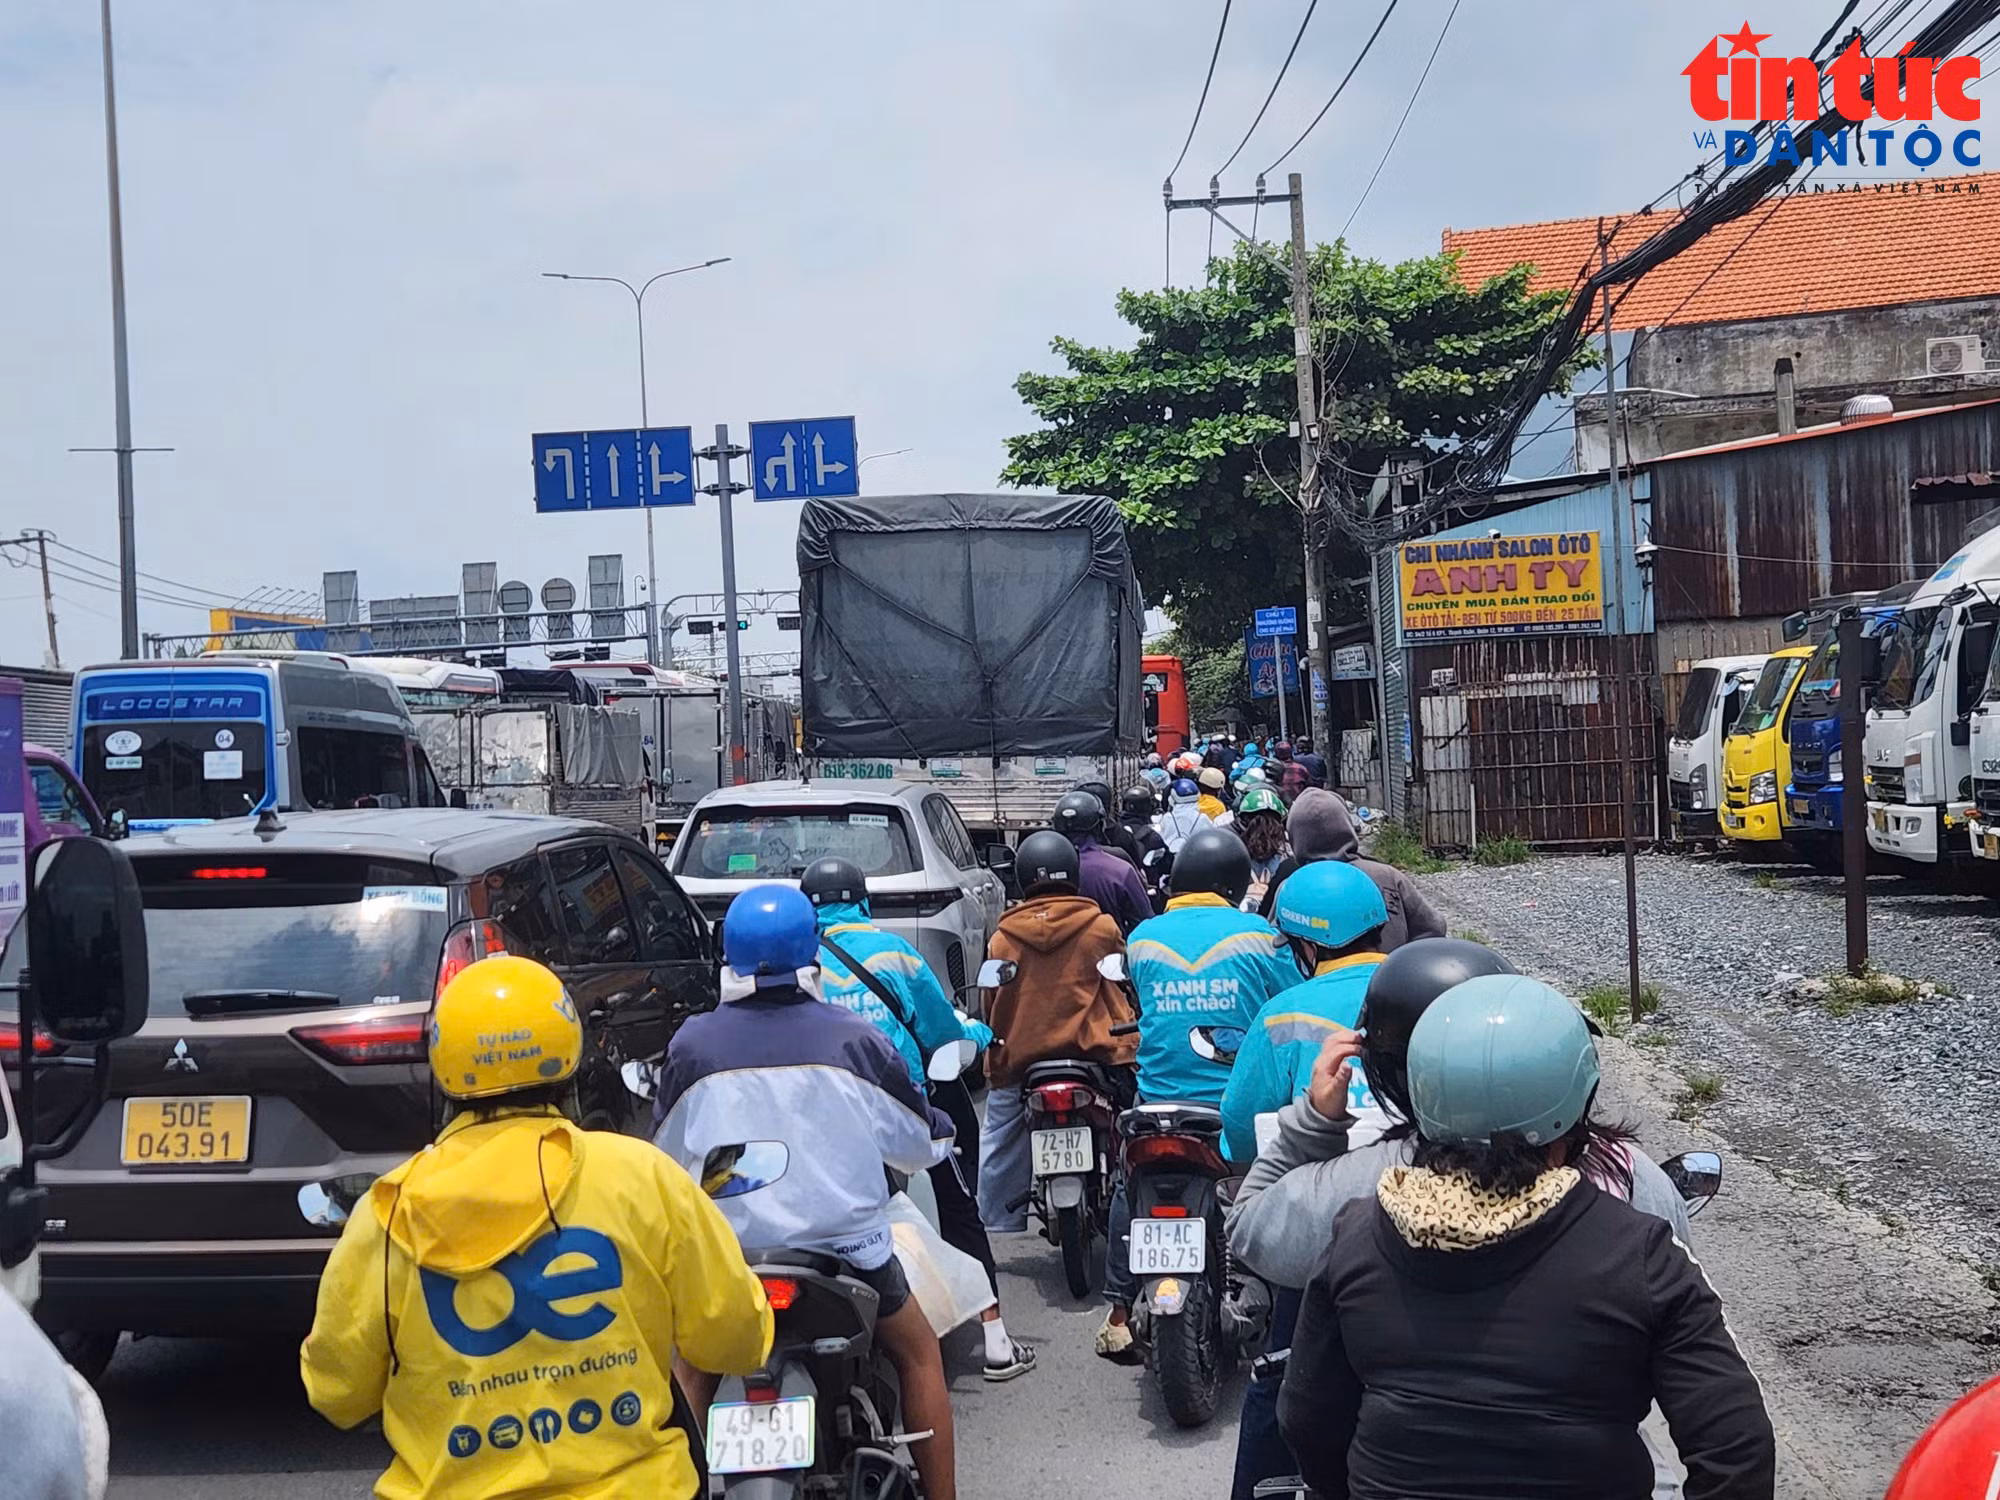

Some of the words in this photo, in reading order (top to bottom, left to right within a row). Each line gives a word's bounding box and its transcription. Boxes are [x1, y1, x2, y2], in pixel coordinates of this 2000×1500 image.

[1405, 545, 1432, 563] CHI
[1436, 540, 1494, 562] NHÁNH
[1498, 538, 1553, 558] SALON
[1558, 533, 1591, 556] ÔTÔ
[1411, 563, 1518, 596] ANH
[1529, 559, 1591, 590] TY
[1407, 600, 1460, 611] CHUYÊN
[1465, 598, 1497, 608] MUA
[1501, 595, 1530, 606] BÁN
[1533, 595, 1567, 605] TRAO
[1405, 617, 1419, 628] XE
[1500, 611, 1532, 624] 500KG
[1561, 609, 1575, 620] 25
[103, 698, 243, 711] LOCOSTAR
[1151, 980, 1206, 997] XANH
[1210, 978, 1239, 994] SM
[1156, 996, 1182, 1013] xin
[1185, 994, 1236, 1012] chào!
[478, 1034, 496, 1047] TỰ
[473, 1051, 503, 1065] VIỆT
[508, 1046, 542, 1061] NAM
[162, 1102, 214, 1127] 50E
[138, 1131, 230, 1158] 043.91
[1041, 1131, 1081, 1151] 72-H7
[1042, 1151, 1084, 1170] 5780
[1144, 1224, 1192, 1245] 81-AC
[1137, 1247, 1198, 1268] 186.75
[481, 1367, 528, 1395] nhau
[533, 1363, 574, 1383] trọn
[579, 1347, 638, 1374] đường
[726, 1404, 794, 1436] 49-G1
[715, 1435, 805, 1468] 718.20
